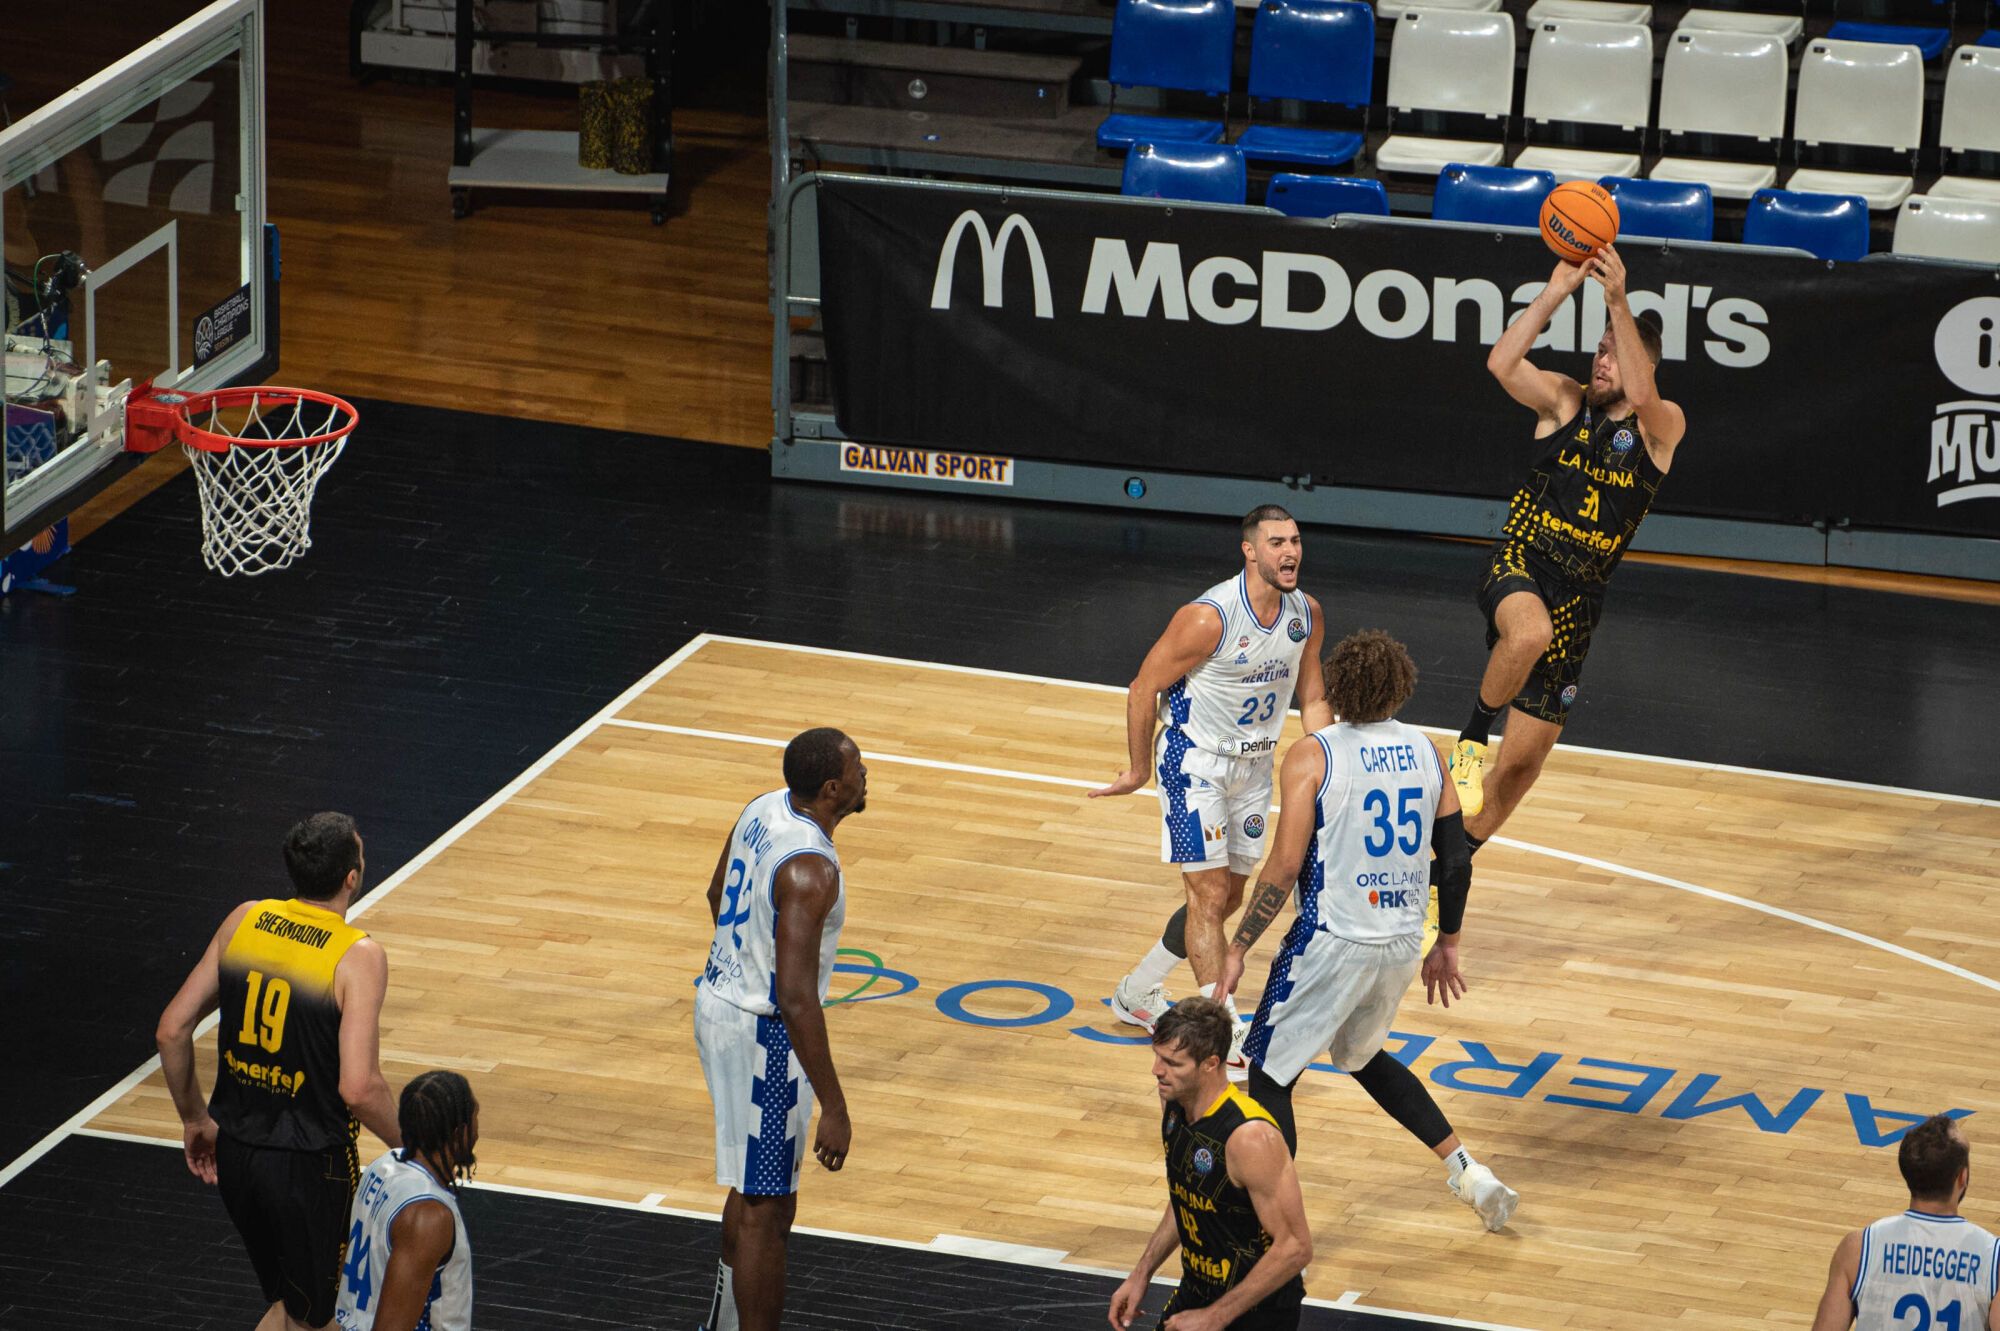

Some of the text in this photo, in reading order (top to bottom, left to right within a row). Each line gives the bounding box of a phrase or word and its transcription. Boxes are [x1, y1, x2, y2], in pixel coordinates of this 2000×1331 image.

[1548, 213, 1593, 254] Wilson
[1081, 236, 1771, 368] McDonald's
[843, 445, 1008, 482] GALVAN SPORT
[1558, 449, 1581, 469] LA
[1237, 692, 1277, 726] 23
[1360, 744, 1418, 773] CARTER
[1363, 787, 1423, 858] 35
[1356, 870, 1423, 887] ORC LAND
[254, 910, 333, 950] SHERMADINI
[238, 970, 291, 1054] 19
[342, 1218, 372, 1312] 44
[1883, 1243, 1981, 1285] HEIDEGGER
